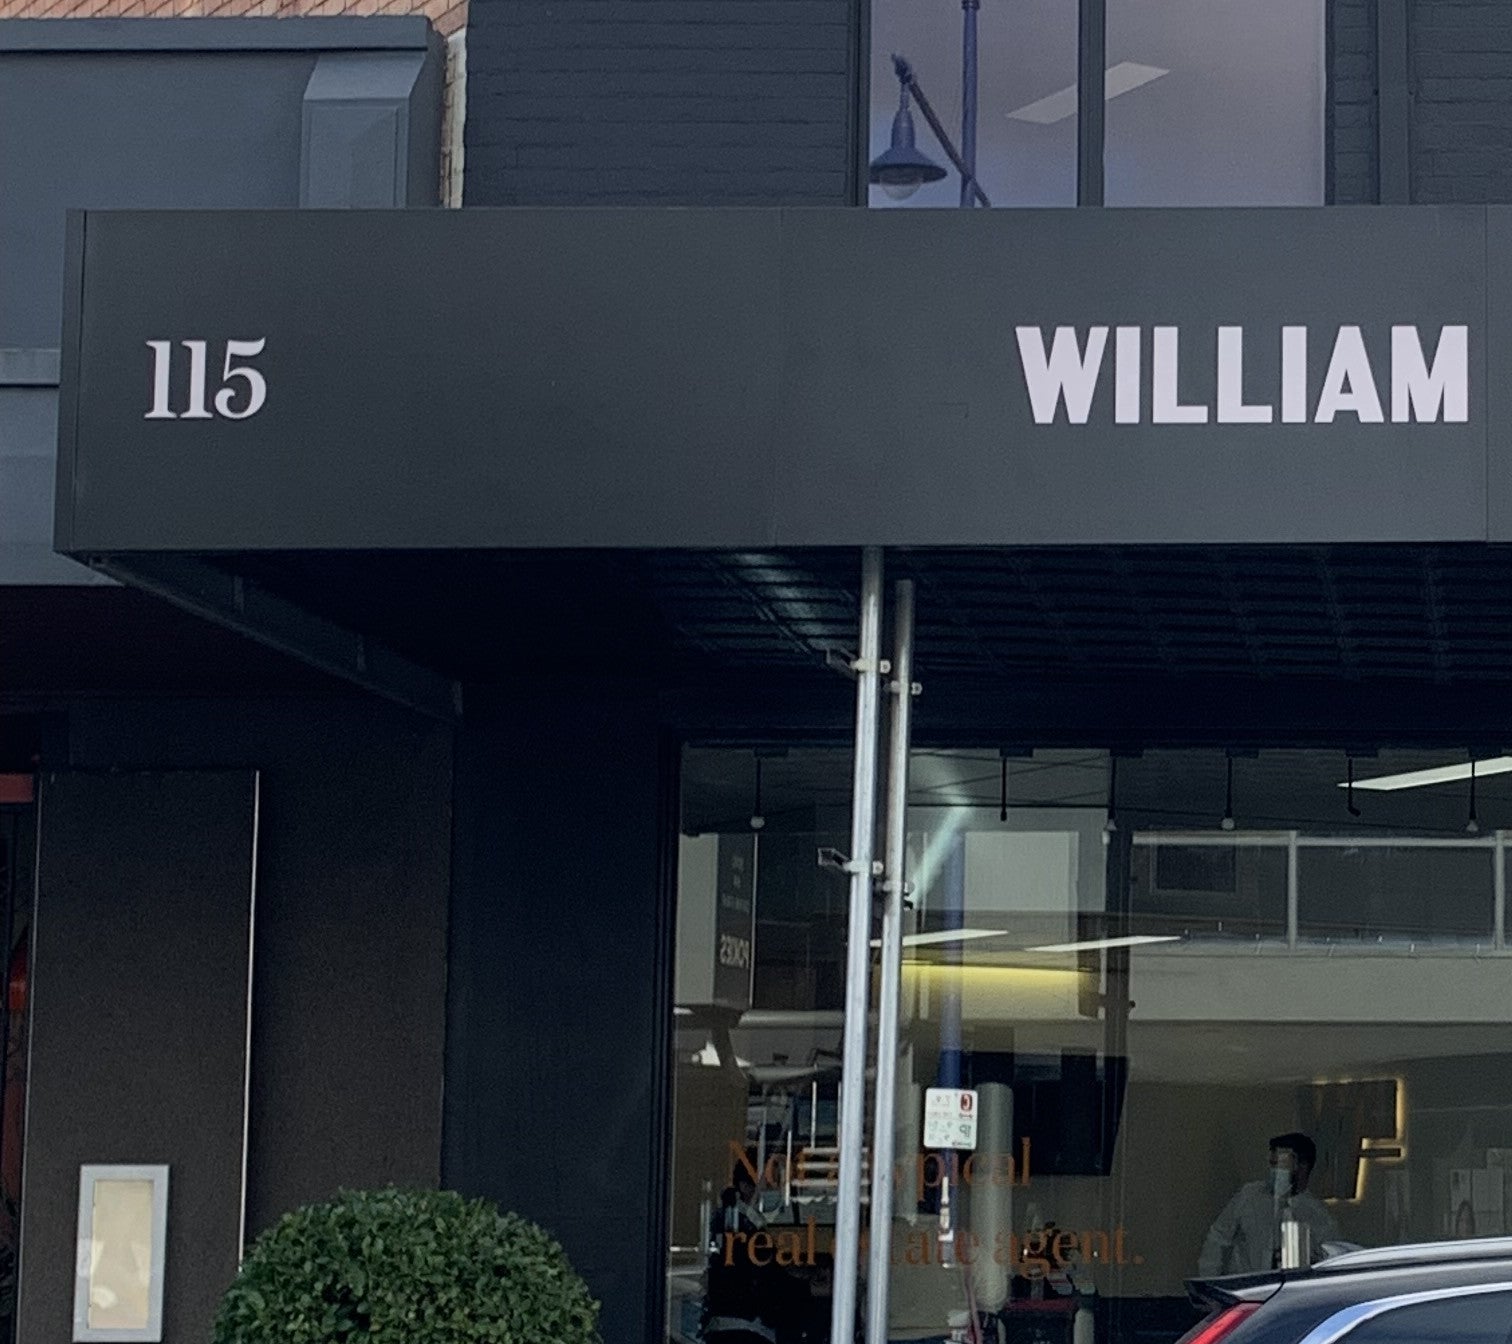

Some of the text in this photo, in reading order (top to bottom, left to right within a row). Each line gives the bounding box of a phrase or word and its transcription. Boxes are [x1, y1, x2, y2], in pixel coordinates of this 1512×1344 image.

[143, 336, 268, 420] 115
[1015, 324, 1469, 424] WILLIAM
[722, 1215, 818, 1267] real
[994, 1225, 1146, 1279] agent.
